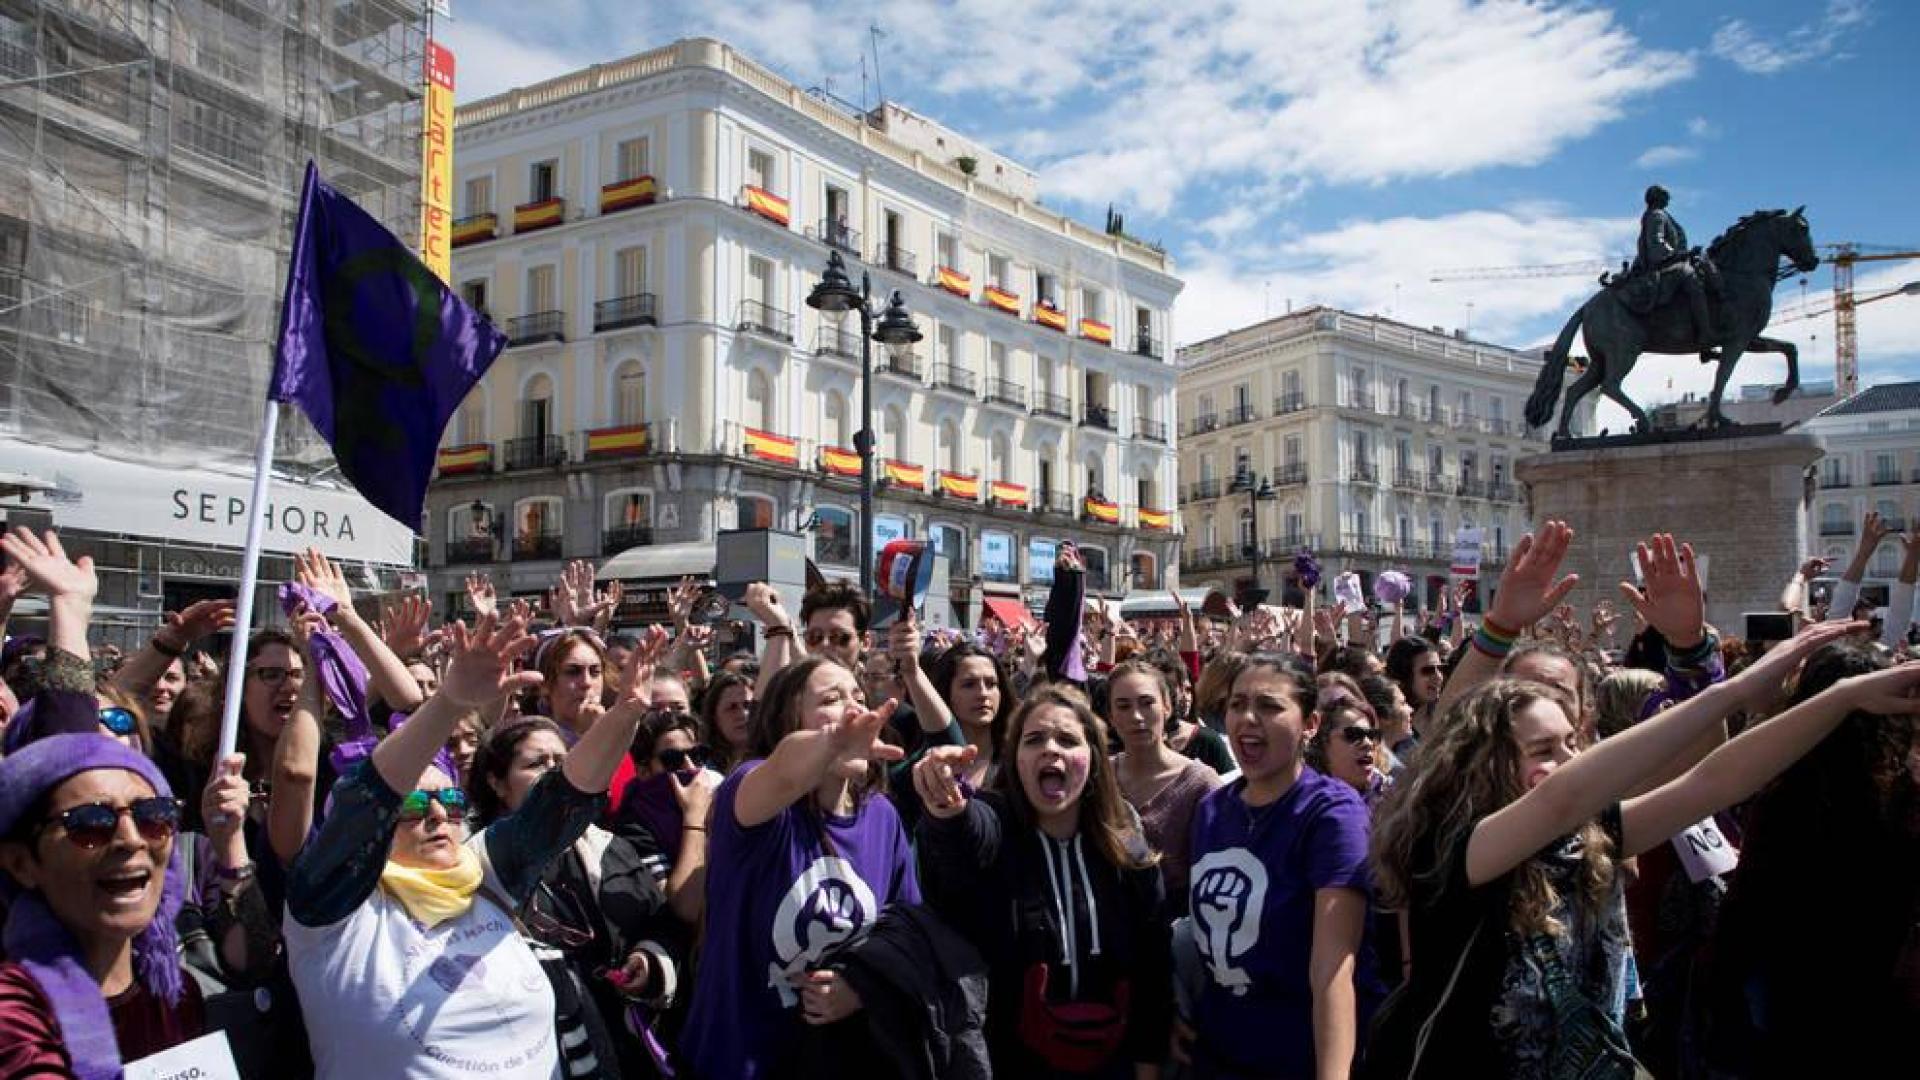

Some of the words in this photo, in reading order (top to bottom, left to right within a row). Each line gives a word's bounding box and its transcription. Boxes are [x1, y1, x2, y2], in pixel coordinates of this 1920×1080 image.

[172, 488, 356, 542] SEPHORA
[169, 559, 241, 578] SEPHOR
[1685, 827, 1723, 856] NO
[424, 1045, 500, 1073] Cuestión
[503, 1056, 523, 1069] de
